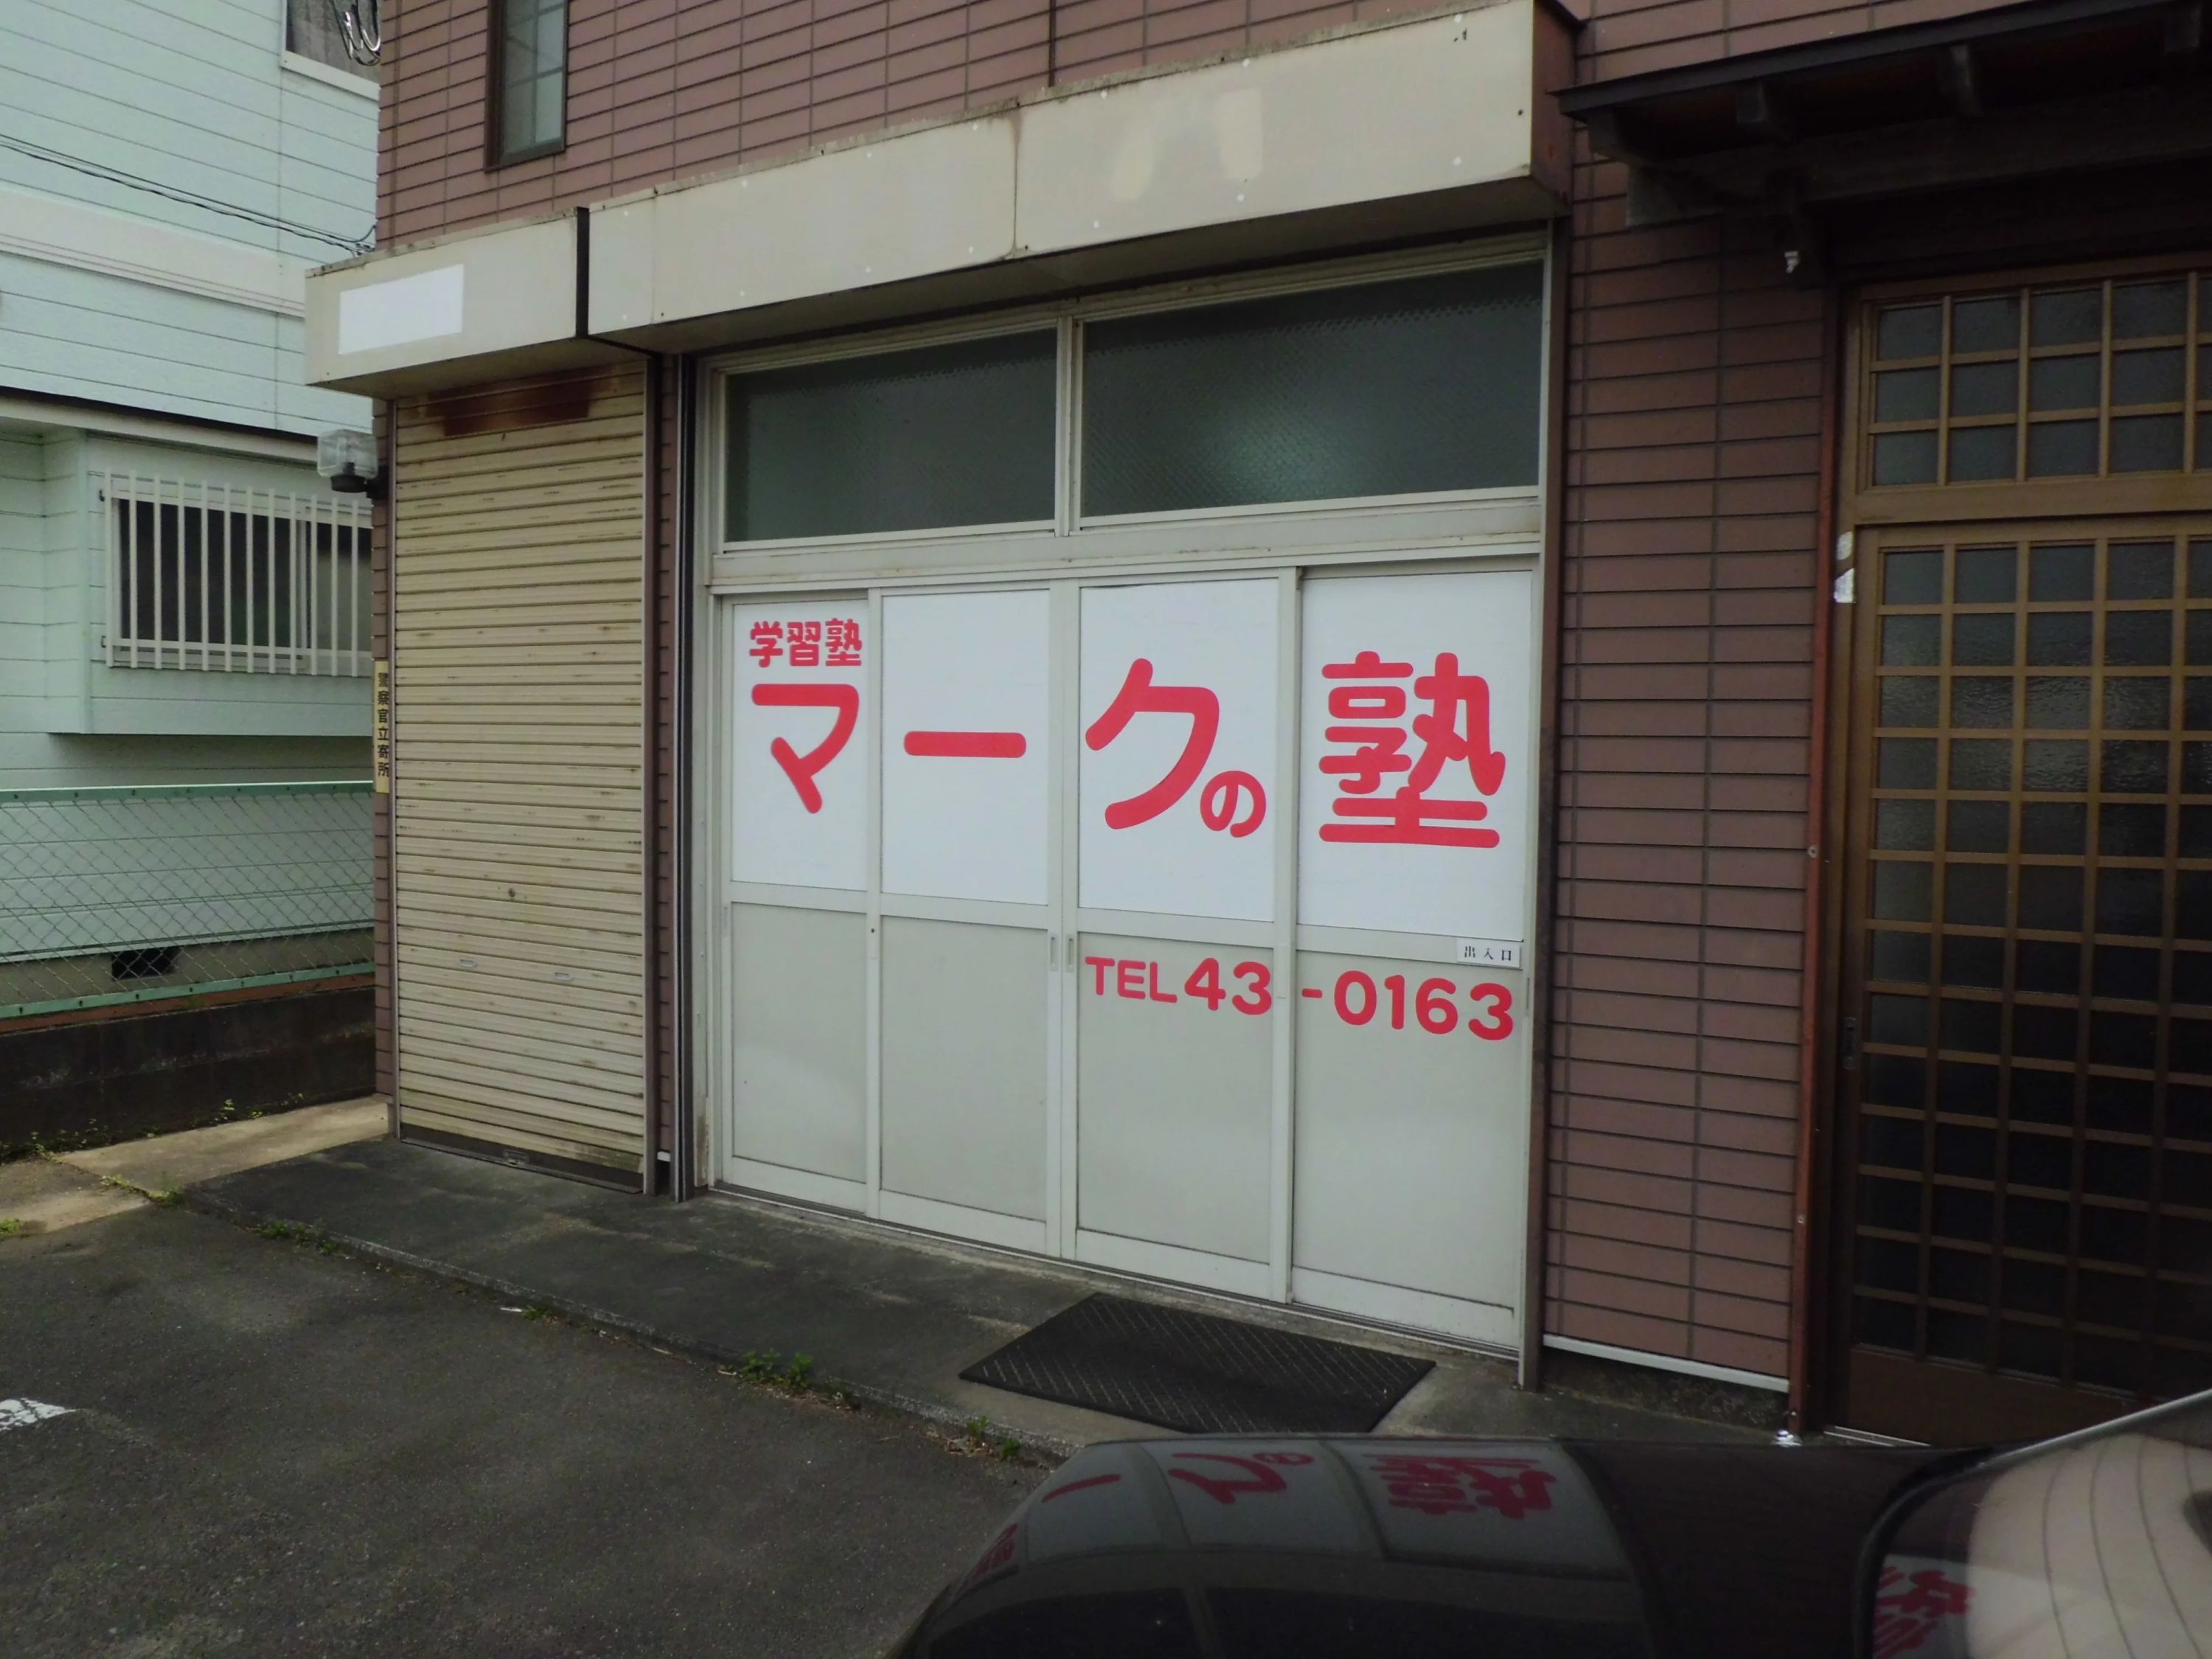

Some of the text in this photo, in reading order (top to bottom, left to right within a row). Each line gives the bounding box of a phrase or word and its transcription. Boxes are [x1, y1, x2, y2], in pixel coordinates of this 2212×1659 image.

[750, 617, 863, 668] 学習塾
[377, 672, 390, 778] 警察官立寄所
[751, 651, 1506, 849] マークの塾
[1464, 945, 1512, 961] 出入口
